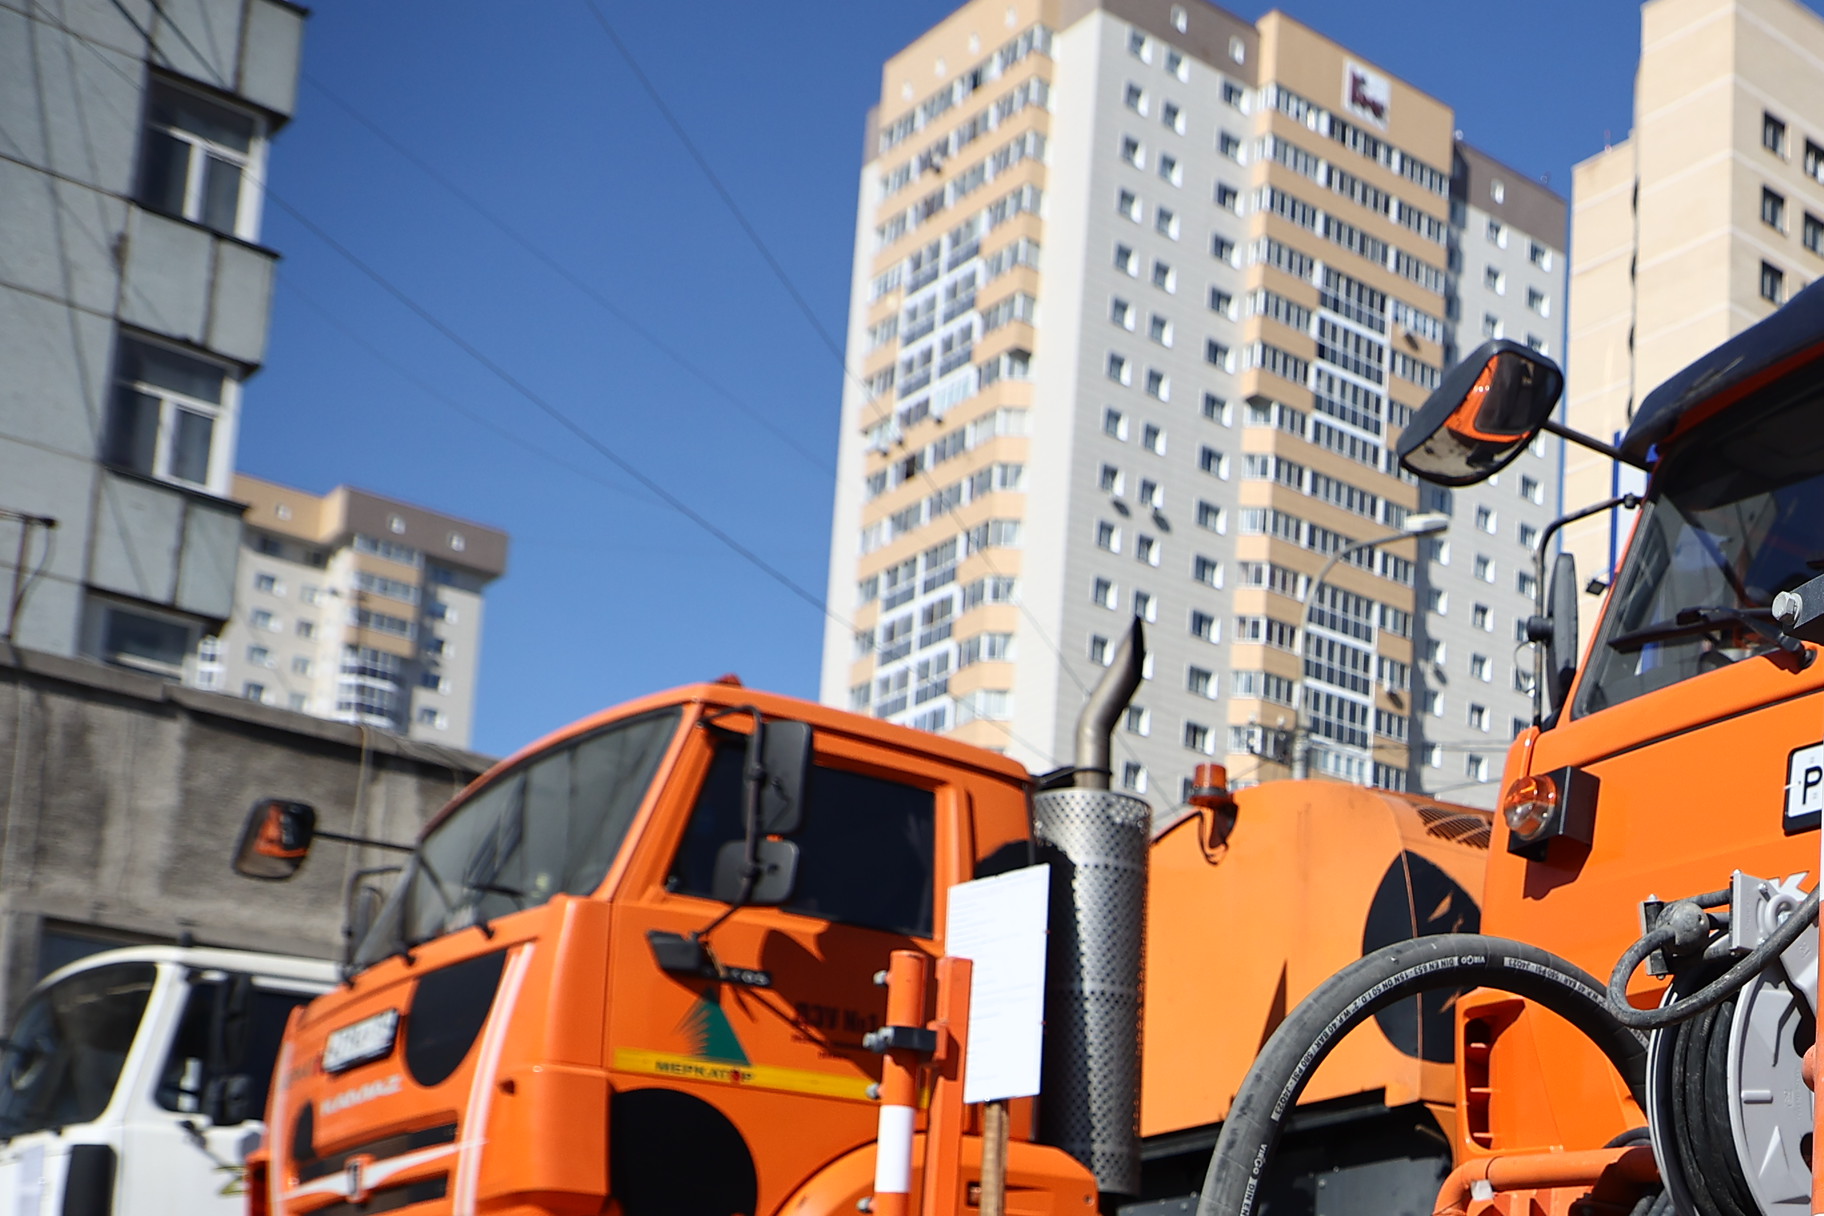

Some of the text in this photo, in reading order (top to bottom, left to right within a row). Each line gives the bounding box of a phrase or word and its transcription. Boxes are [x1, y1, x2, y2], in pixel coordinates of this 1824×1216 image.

[1429, 961, 1440, 970] EN
[1441, 959, 1454, 967] DIN
[1315, 1029, 1330, 1047] BAR
[1246, 1183, 1255, 1200] DIN
